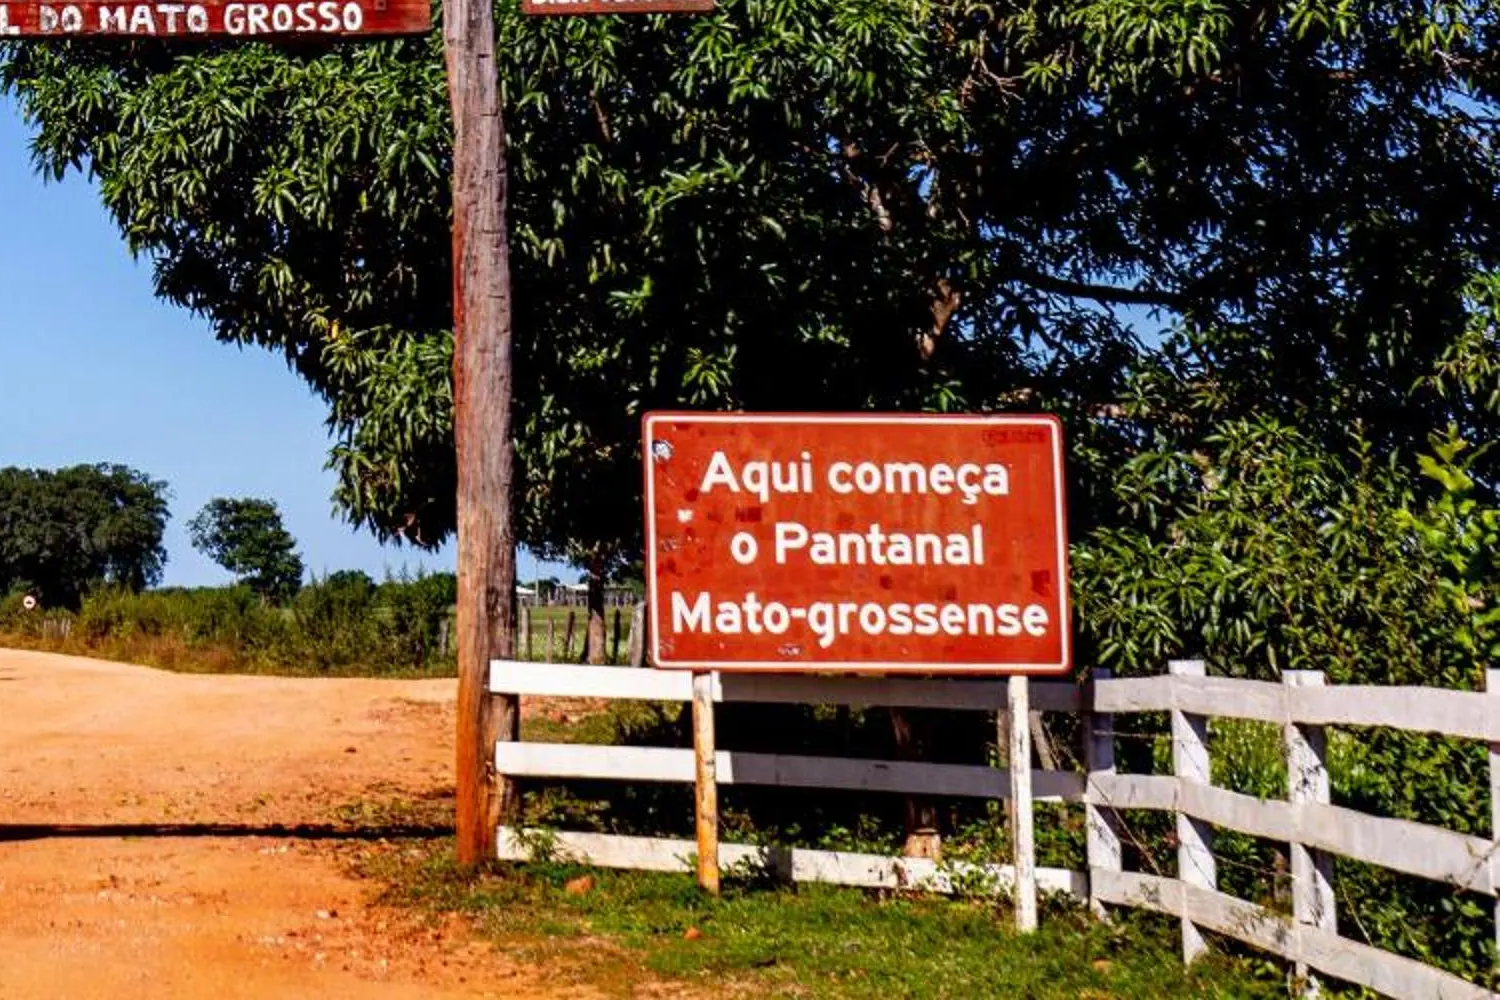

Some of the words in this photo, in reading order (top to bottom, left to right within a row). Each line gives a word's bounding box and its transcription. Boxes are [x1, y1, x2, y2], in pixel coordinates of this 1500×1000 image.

[100, 2, 208, 32] MATO
[224, 1, 363, 32] GROSSO
[701, 451, 813, 502] Aqui
[828, 462, 1010, 505] começa
[730, 530, 758, 564] o
[775, 522, 985, 566] Pantanal
[671, 591, 1050, 649] Mato-grossense
